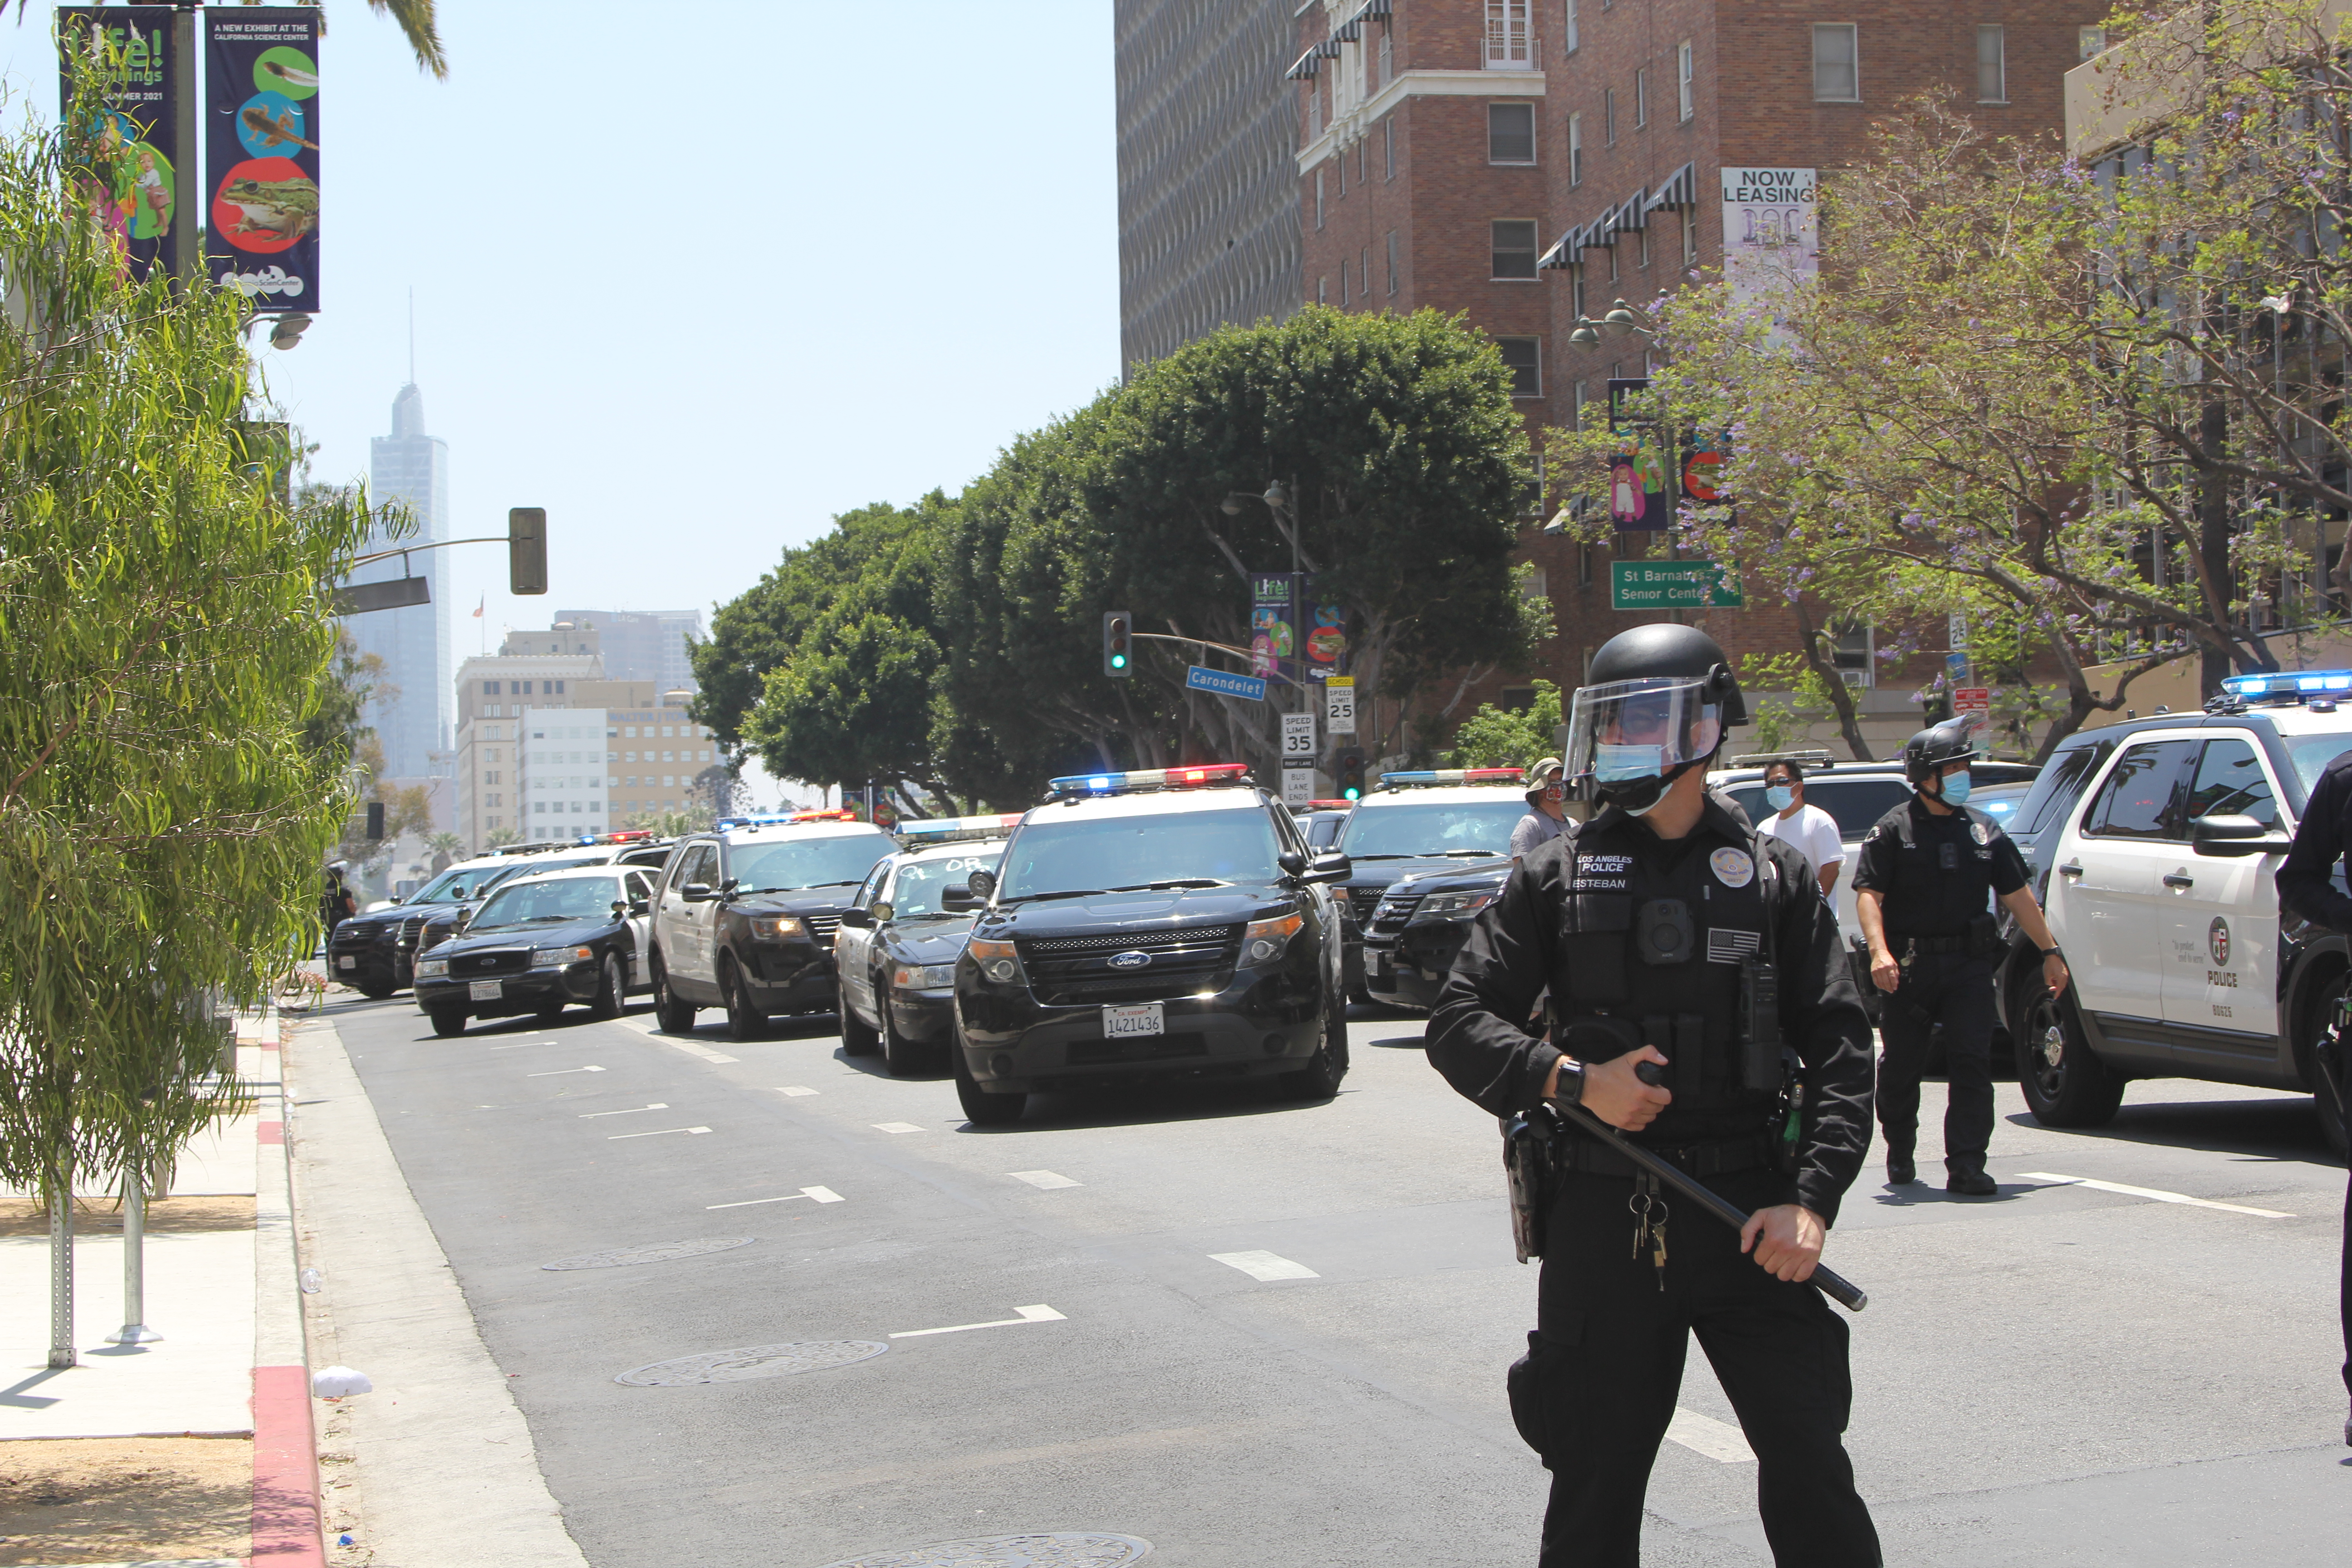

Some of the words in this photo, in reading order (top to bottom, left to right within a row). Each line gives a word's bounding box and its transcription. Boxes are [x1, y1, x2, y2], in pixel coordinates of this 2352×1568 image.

[143, 92, 162, 100] 2021
[1742, 171, 1795, 186] NOW
[1724, 187, 1814, 202] LEASING
[1624, 571, 1639, 581] St
[1645, 570, 1705, 581] Barnabs
[1254, 579, 1289, 595] Life!
[1622, 589, 1662, 600] Senior
[1668, 588, 1708, 599] Cente
[1192, 671, 1261, 695] Carondelet
[608, 713, 655, 722] WALTER
[665, 712, 689, 721] TOW
[1330, 705, 1352, 717] 25
[1288, 736, 1310, 751] 35
[1594, 855, 1633, 863] ANGELES
[1582, 863, 1624, 872] POLICE
[1572, 879, 1626, 888] ESTEBAN
[1117, 955, 1142, 965] Ford
[2208, 970, 2238, 988] POLICE
[2212, 1004, 2232, 1018] 80625
[1108, 1016, 1159, 1033] 1421436
